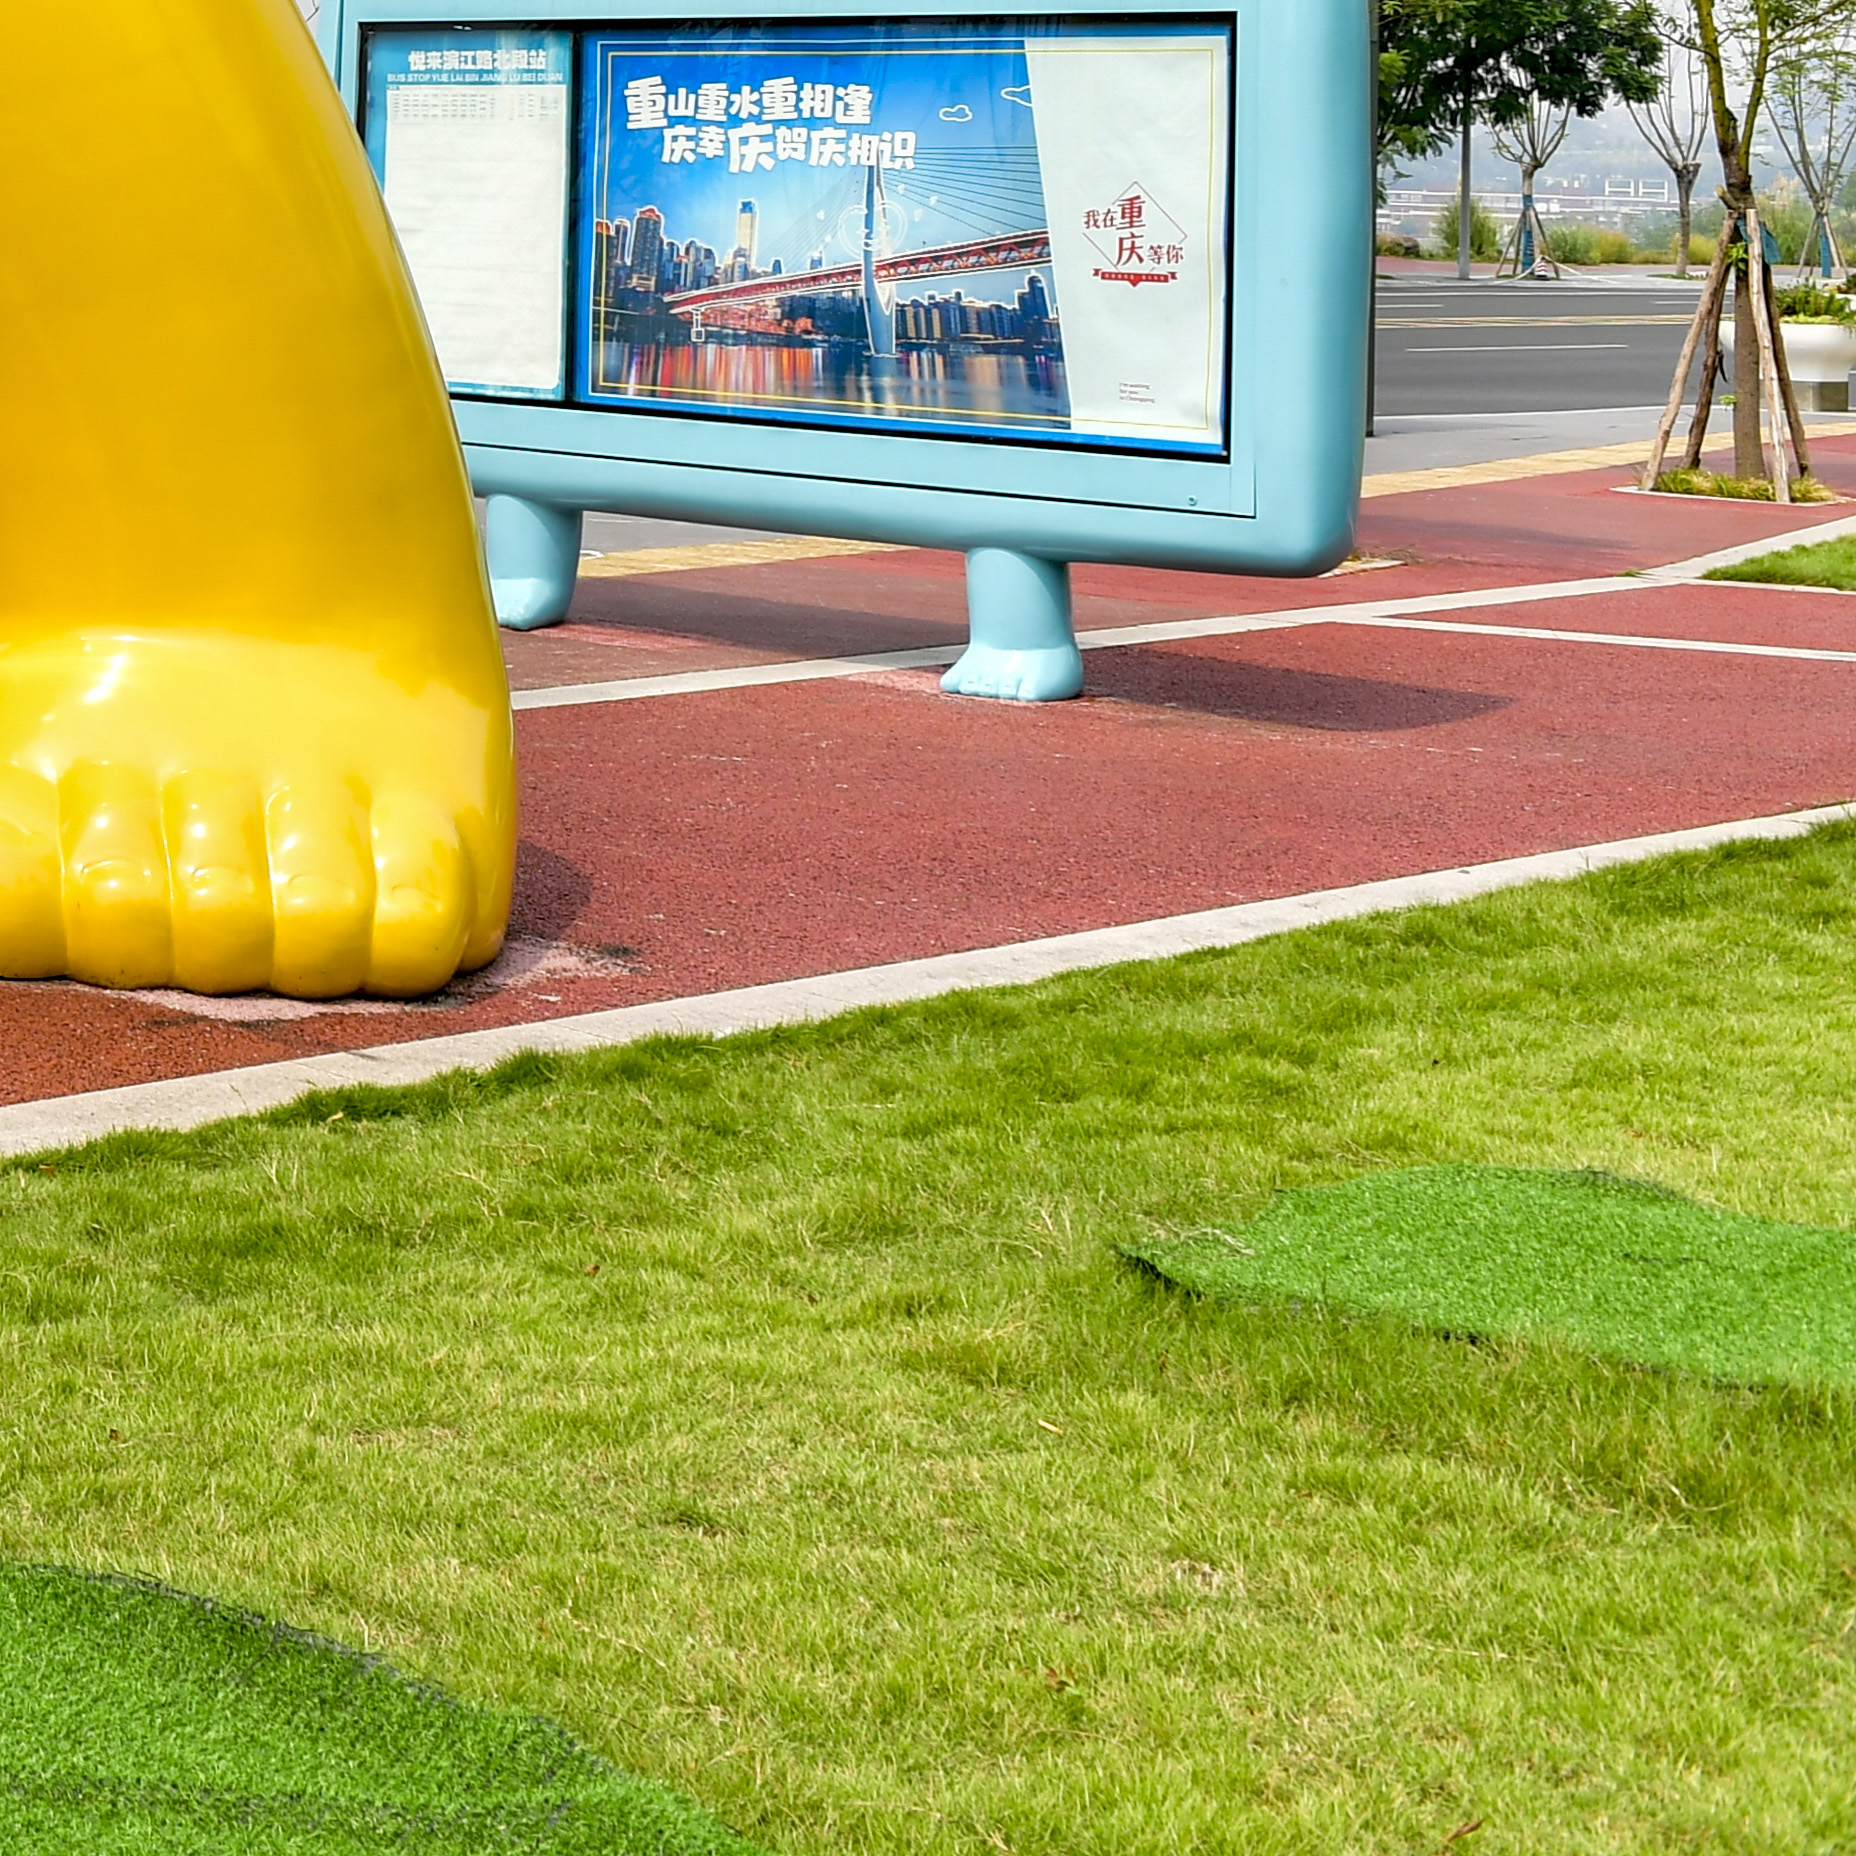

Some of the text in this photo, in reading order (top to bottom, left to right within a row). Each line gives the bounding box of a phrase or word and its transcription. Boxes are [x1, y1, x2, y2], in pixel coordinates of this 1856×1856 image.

[407, 73, 431, 82] STOP
[624, 75, 873, 130] 重山重水重相逢
[661, 121, 916, 174] 庆幸庆贺庆相识
